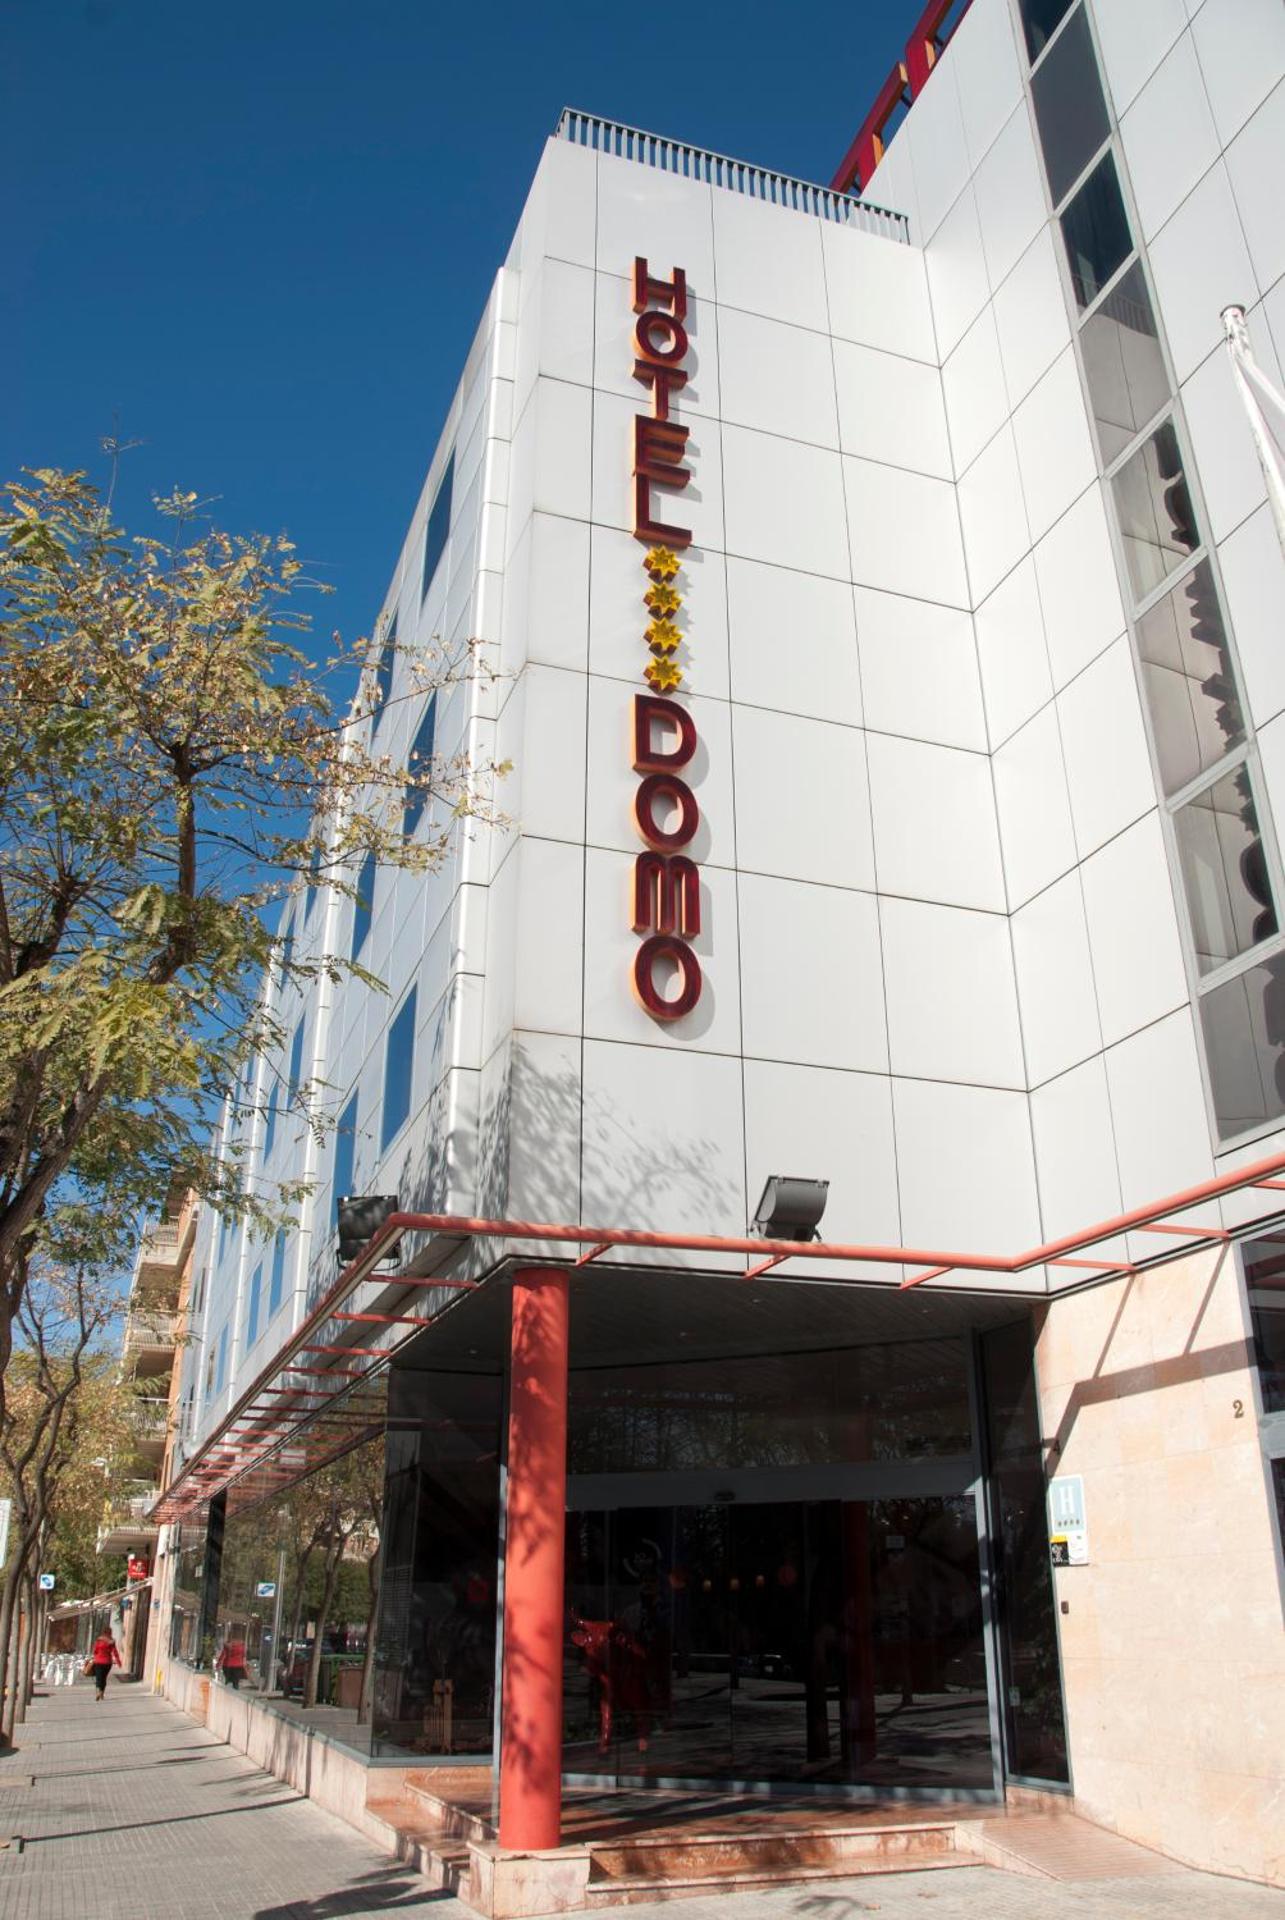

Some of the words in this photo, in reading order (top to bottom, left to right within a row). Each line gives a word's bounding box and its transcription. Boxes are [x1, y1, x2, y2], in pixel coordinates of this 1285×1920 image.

[632, 256, 693, 548] HOTEL
[1232, 1398, 1244, 1418] 2
[1059, 1485, 1075, 1515] H
